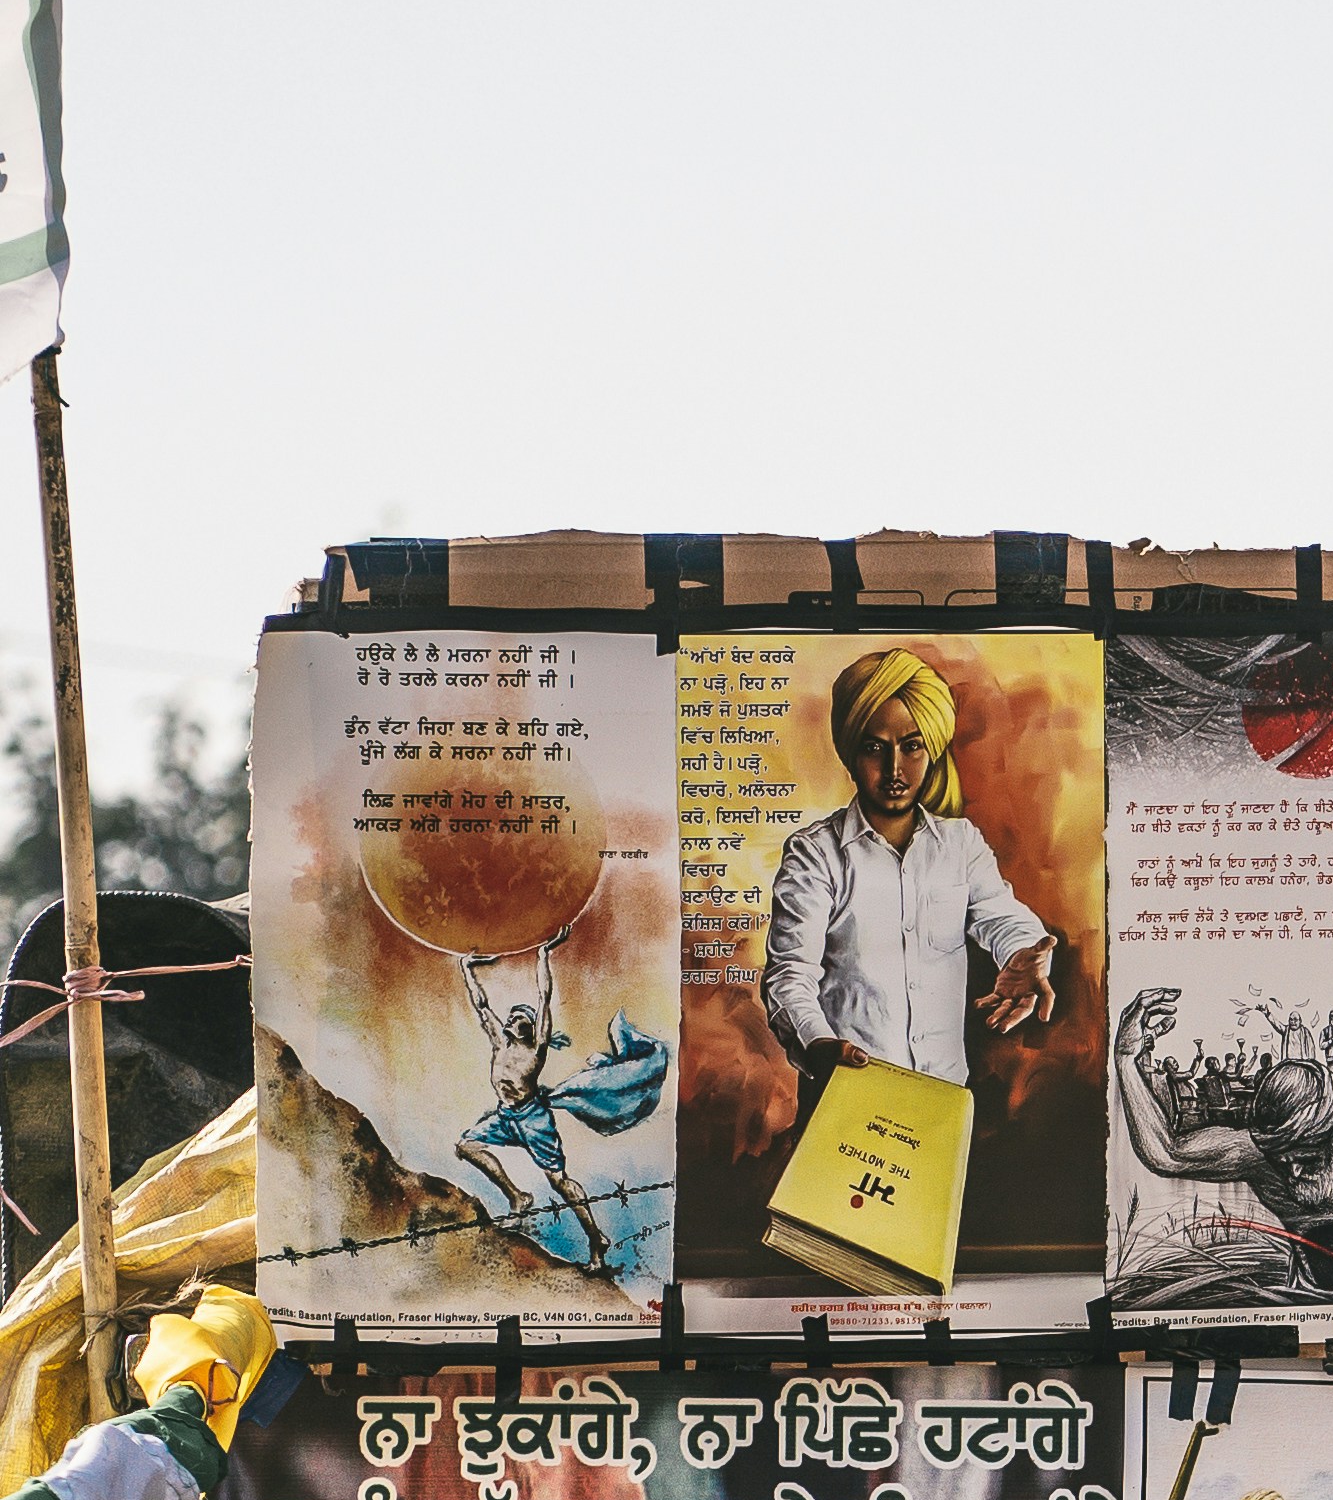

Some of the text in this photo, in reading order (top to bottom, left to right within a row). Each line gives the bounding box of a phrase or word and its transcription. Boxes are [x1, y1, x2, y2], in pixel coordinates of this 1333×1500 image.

[355, 643, 559, 665] ਹਉਕੇ ਲੈ ਲੈ ਮਰਨਾ ਨਹੀਂ ਜੀ
[731, 646, 754, 663] ਬੰਦ
[760, 646, 796, 663] ਕਰਕੇ
[357, 666, 558, 688] ਰੋ ਰੋ ਤਰਲੇ ਕਰਨਾ ਨਹੀਂ ਜੀ
[680, 678, 698, 690] ਨਾ
[740, 674, 766, 690] ਇਹ
[771, 678, 789, 690] ਨਾ
[837, 1143, 912, 1181] THE MOTHER
[358, 1393, 436, 1468] ਨਾ
[679, 1393, 760, 1468] ਨਾ
[774, 1377, 904, 1472] ਪਿੱਛੇ
[915, 1379, 1094, 1472] ਹਟਾਂਗੇ
